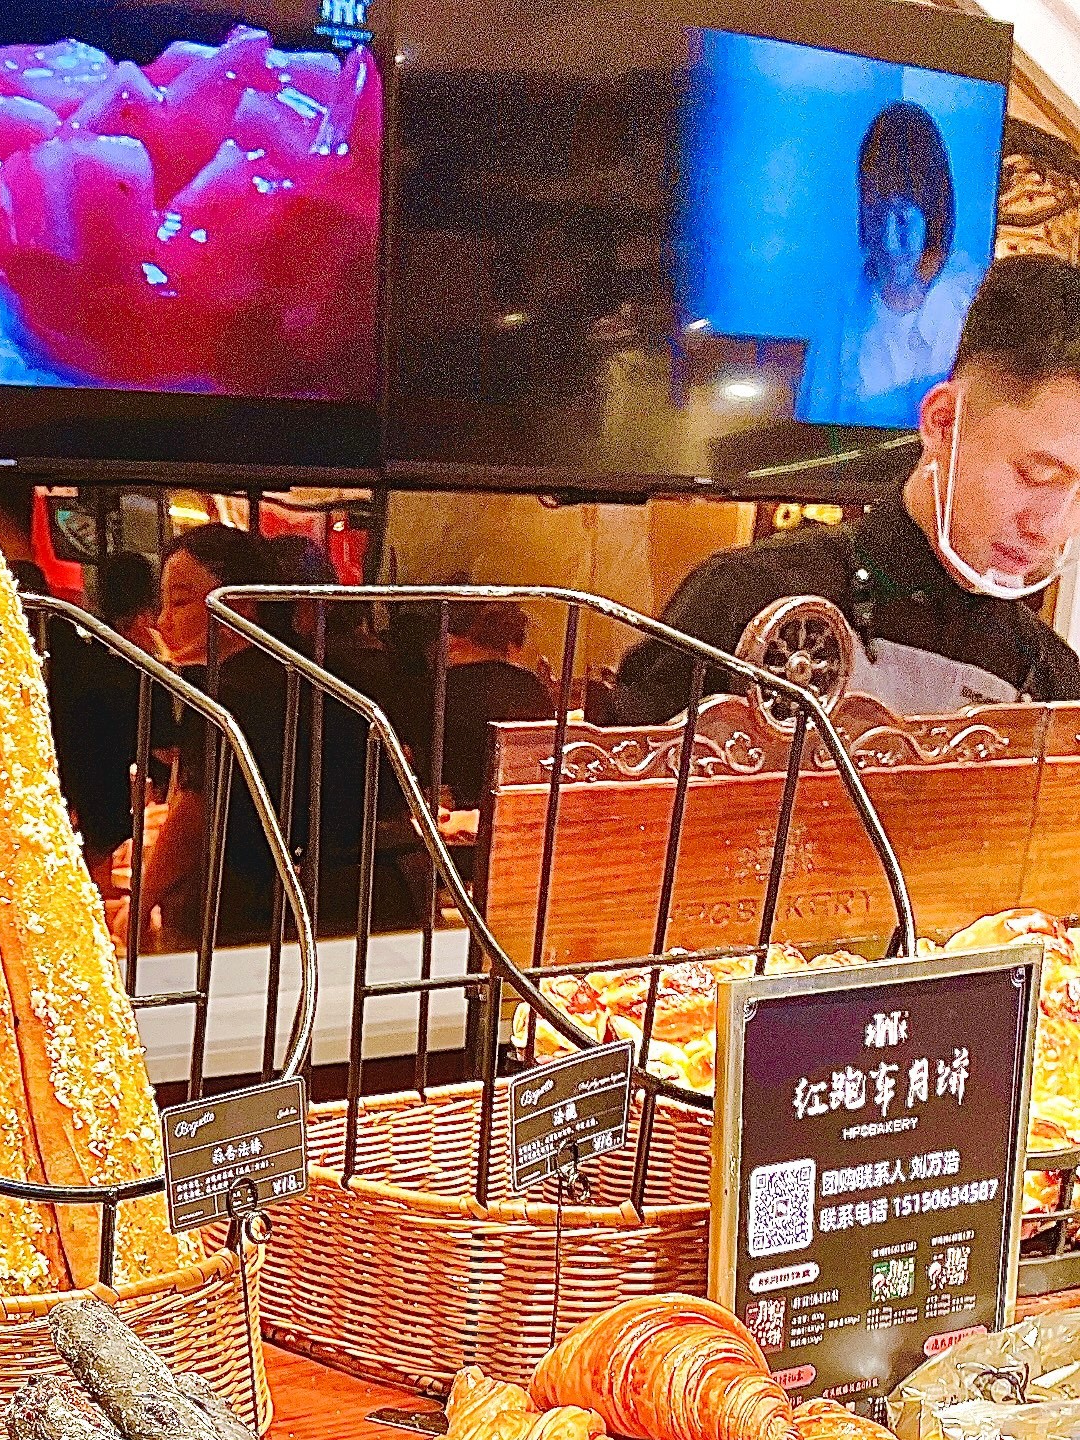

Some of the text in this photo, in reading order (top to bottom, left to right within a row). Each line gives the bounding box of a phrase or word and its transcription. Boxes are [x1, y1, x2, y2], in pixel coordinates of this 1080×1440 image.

[821, 1158, 906, 1197] 团购联系人
[819, 1197, 889, 1232] 联系电话
